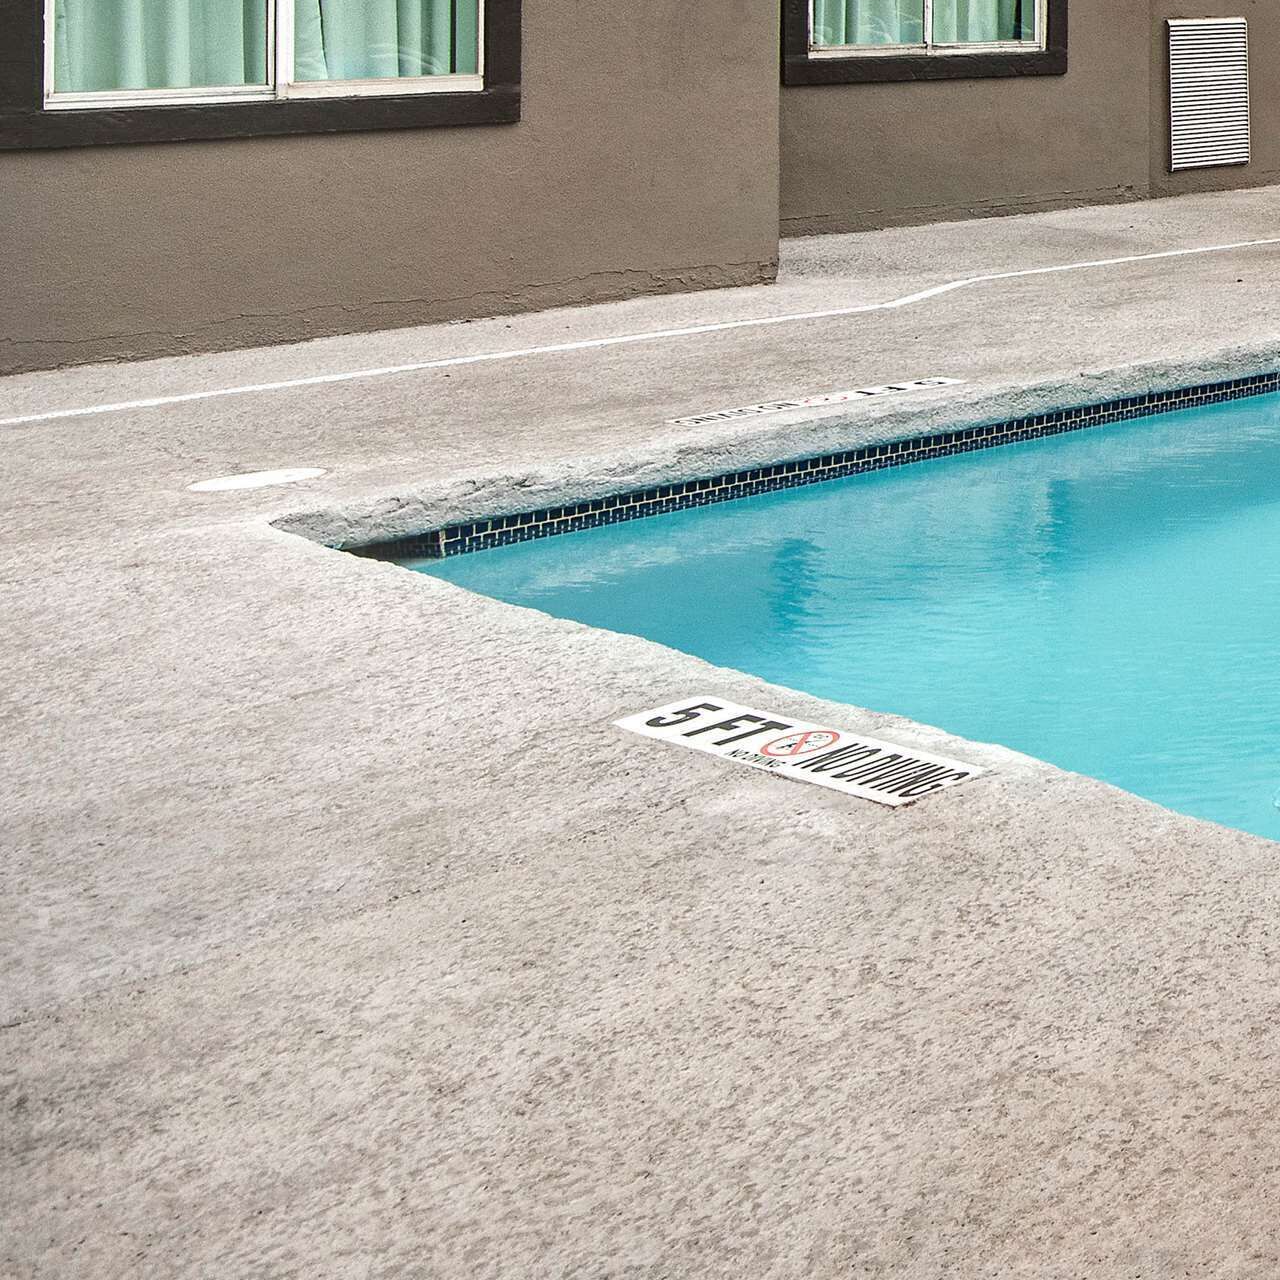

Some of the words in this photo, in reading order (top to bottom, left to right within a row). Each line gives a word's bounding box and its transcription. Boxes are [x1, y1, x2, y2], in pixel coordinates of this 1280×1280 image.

[856, 385, 907, 396] FT
[645, 703, 723, 727] 5
[681, 714, 794, 746] FT
[791, 742, 882, 772] NO
[830, 753, 970, 798] DIVING
